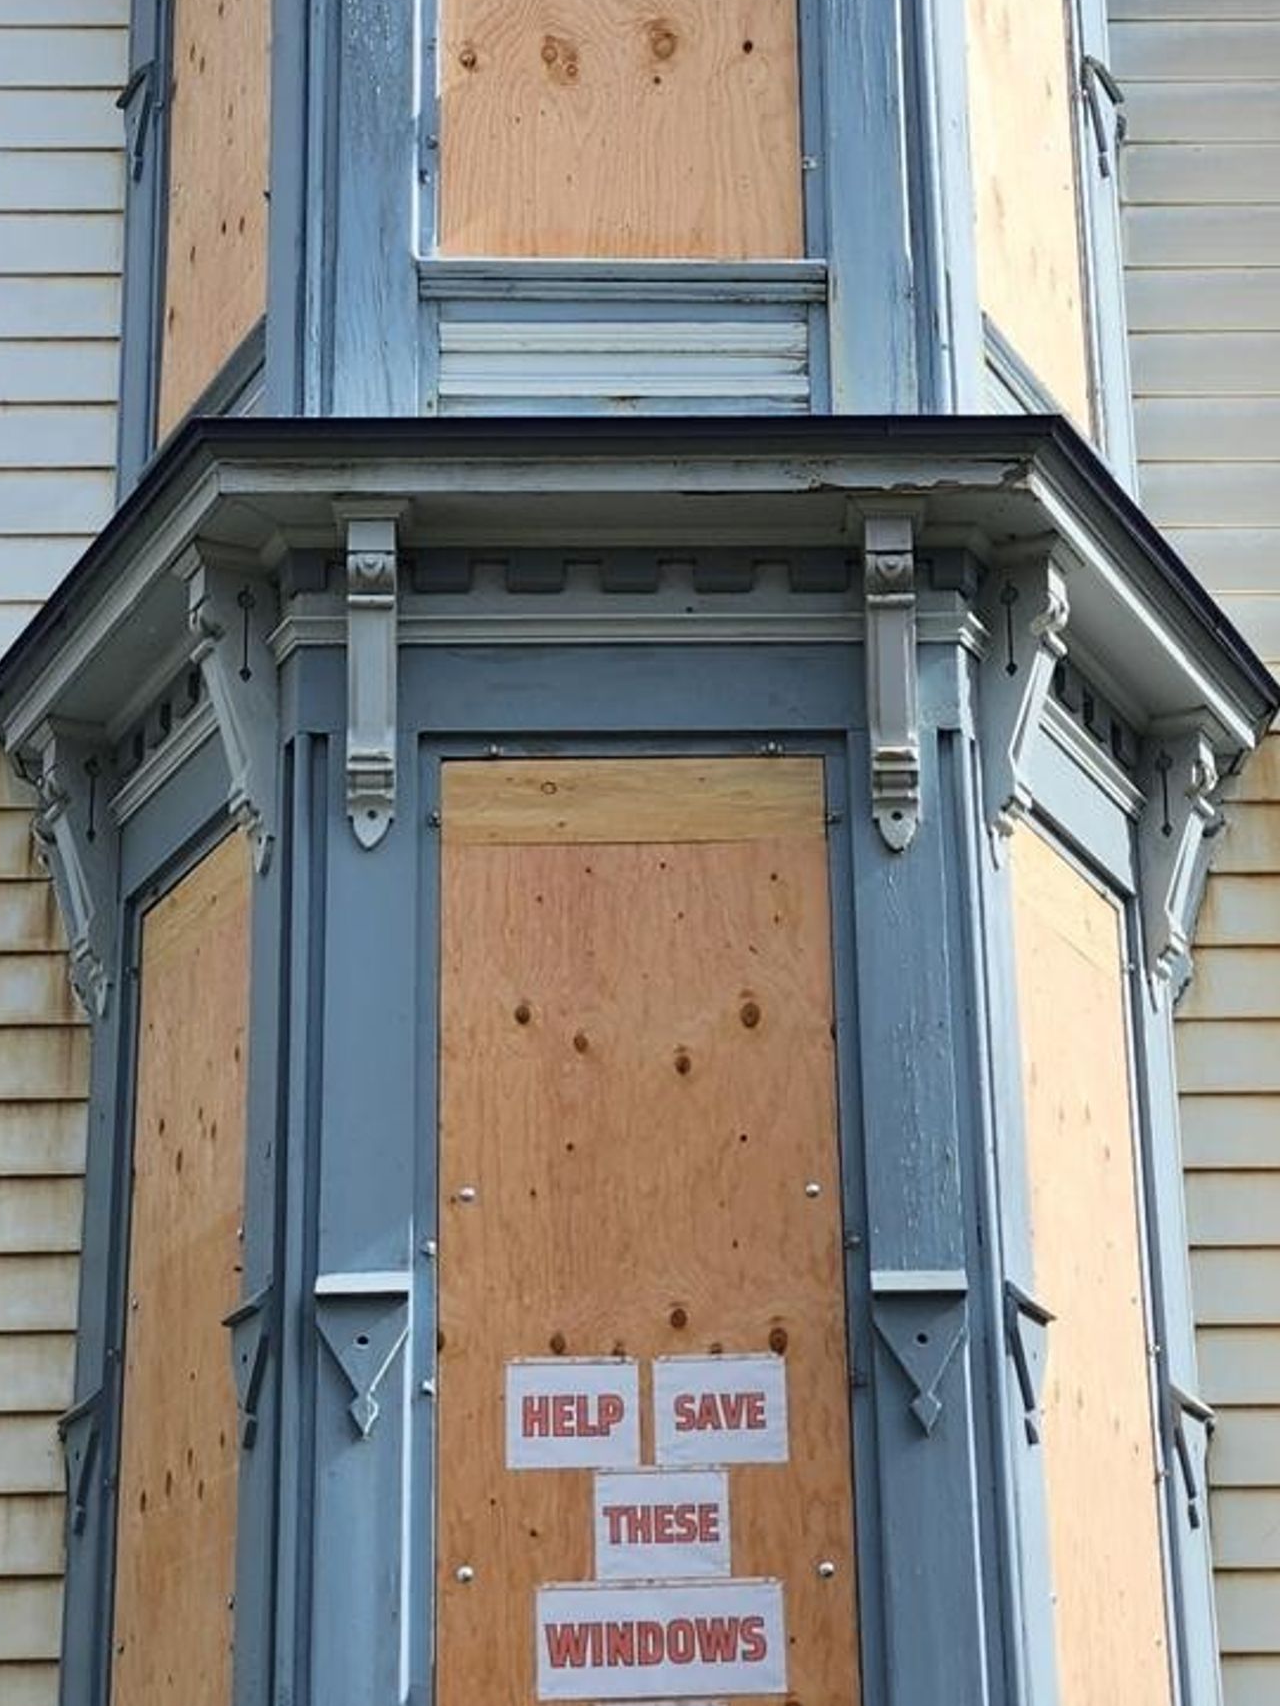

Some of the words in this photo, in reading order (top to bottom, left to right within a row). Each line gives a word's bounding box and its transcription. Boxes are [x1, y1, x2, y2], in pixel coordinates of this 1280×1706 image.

[521, 1394, 625, 1438] HELP
[673, 1392, 767, 1433] SAVE
[602, 1502, 721, 1546] THESE
[544, 1616, 768, 1669] WINDOWS
